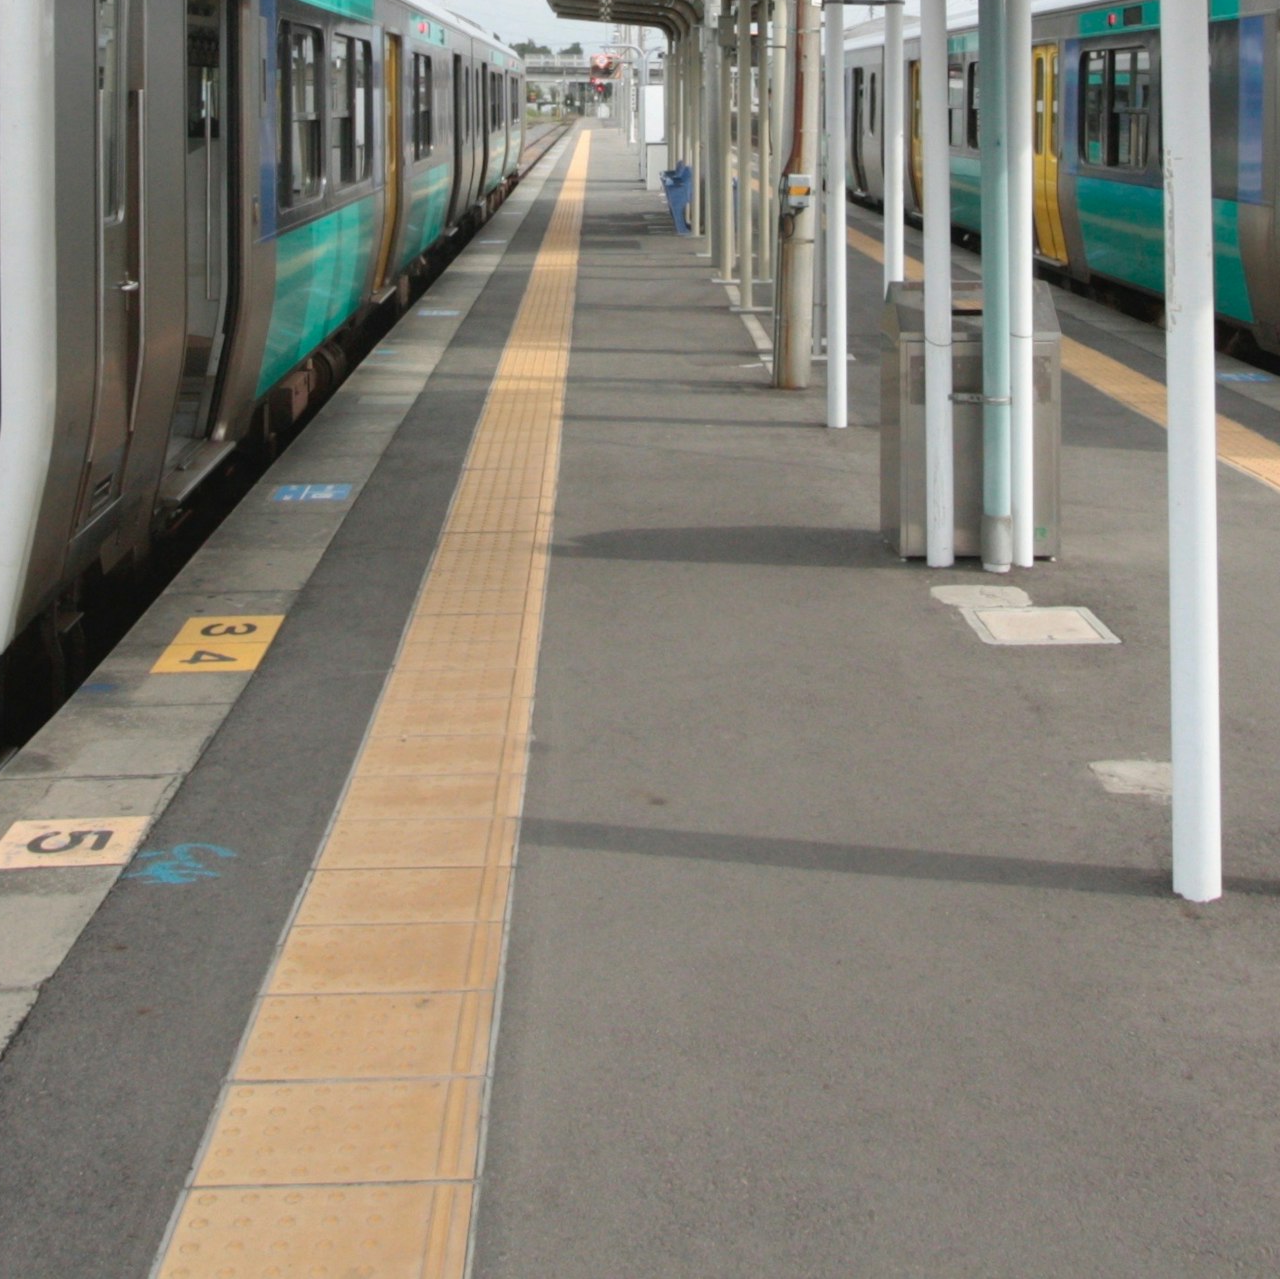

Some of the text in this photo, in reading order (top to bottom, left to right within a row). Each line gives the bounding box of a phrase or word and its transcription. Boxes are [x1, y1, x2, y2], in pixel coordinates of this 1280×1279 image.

[200, 623, 257, 637] 3
[178, 650, 238, 664] 4
[26, 830, 114, 854] 5
